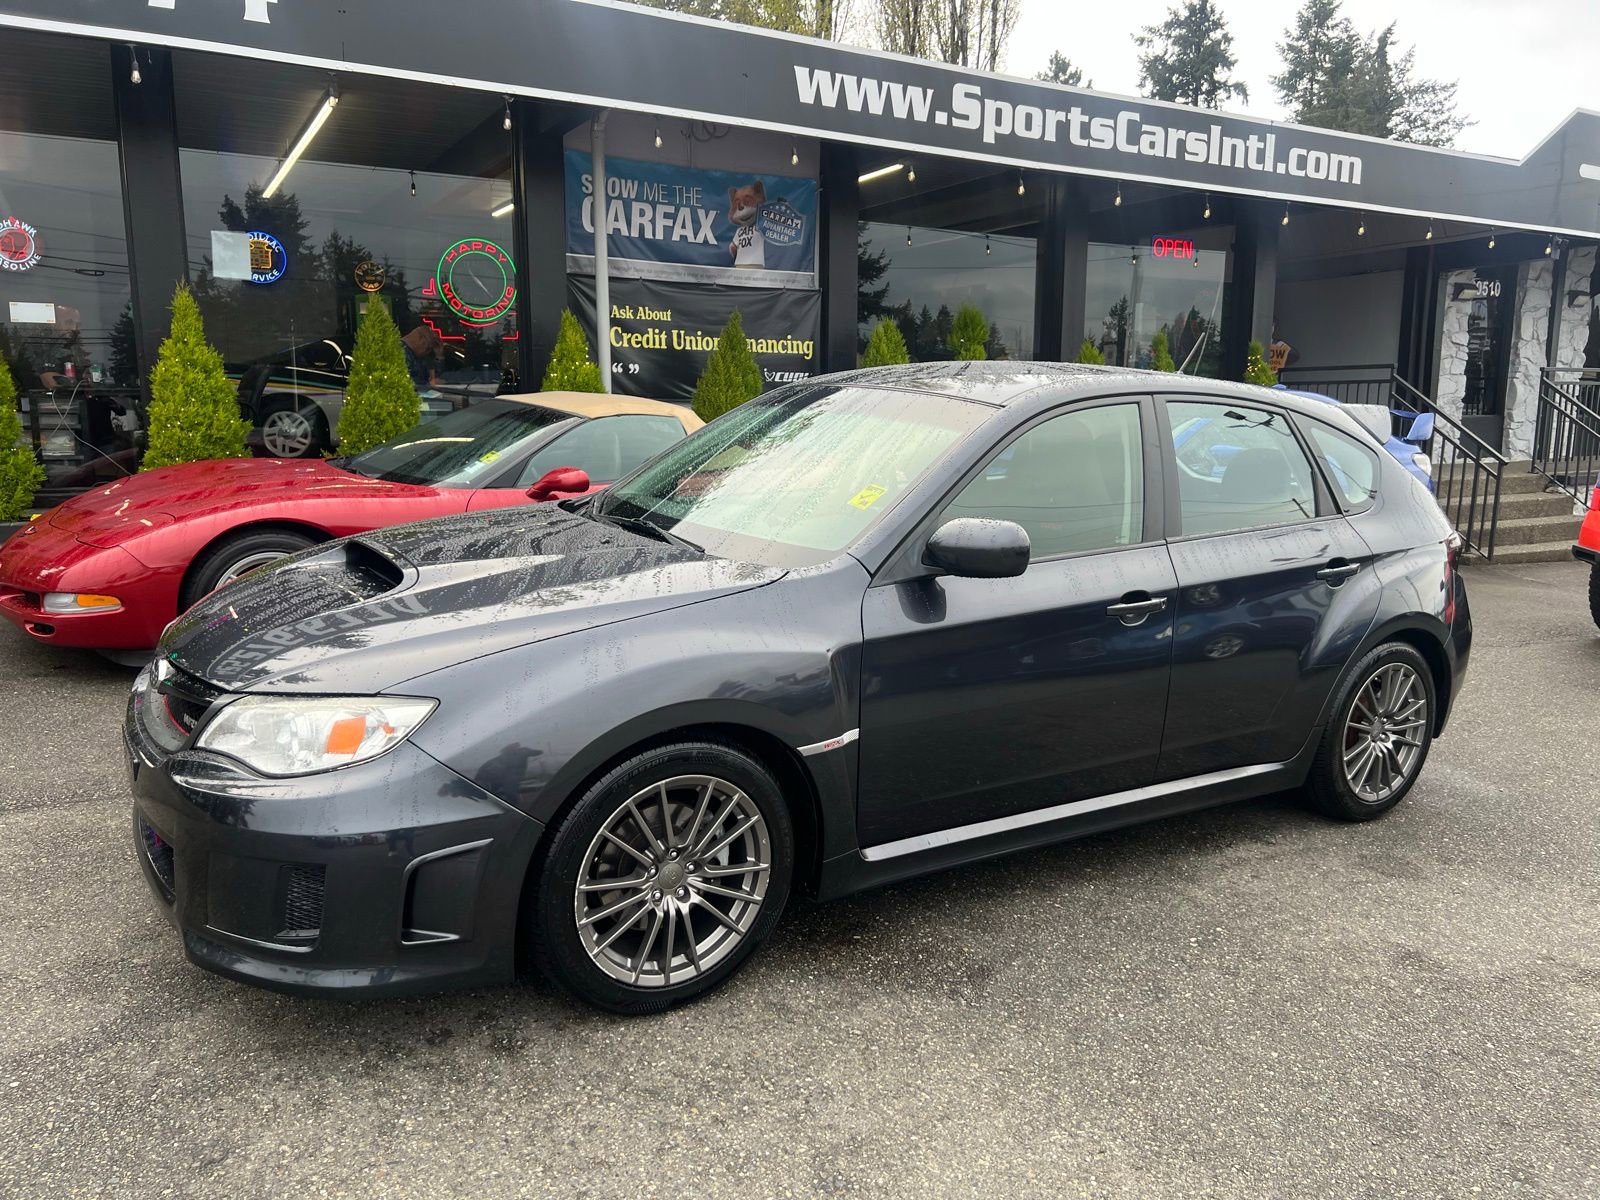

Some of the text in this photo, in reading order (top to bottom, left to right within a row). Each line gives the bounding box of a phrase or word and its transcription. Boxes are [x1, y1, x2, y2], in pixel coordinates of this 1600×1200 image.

[794, 65, 1361, 184] www.SportsCarsIntl.com
[581, 174, 702, 207] SOW ME THE
[762, 210, 801, 229] CARFAX
[763, 220, 796, 236] ADVANTAGE
[765, 231, 789, 242] DEALER
[446, 242, 507, 263] HAPPY
[1153, 238, 1193, 259] OPEN
[442, 283, 514, 318] MOTORING
[611, 305, 671, 321] Ask About
[610, 326, 667, 349] Credit
[746, 334, 813, 359] nancing
